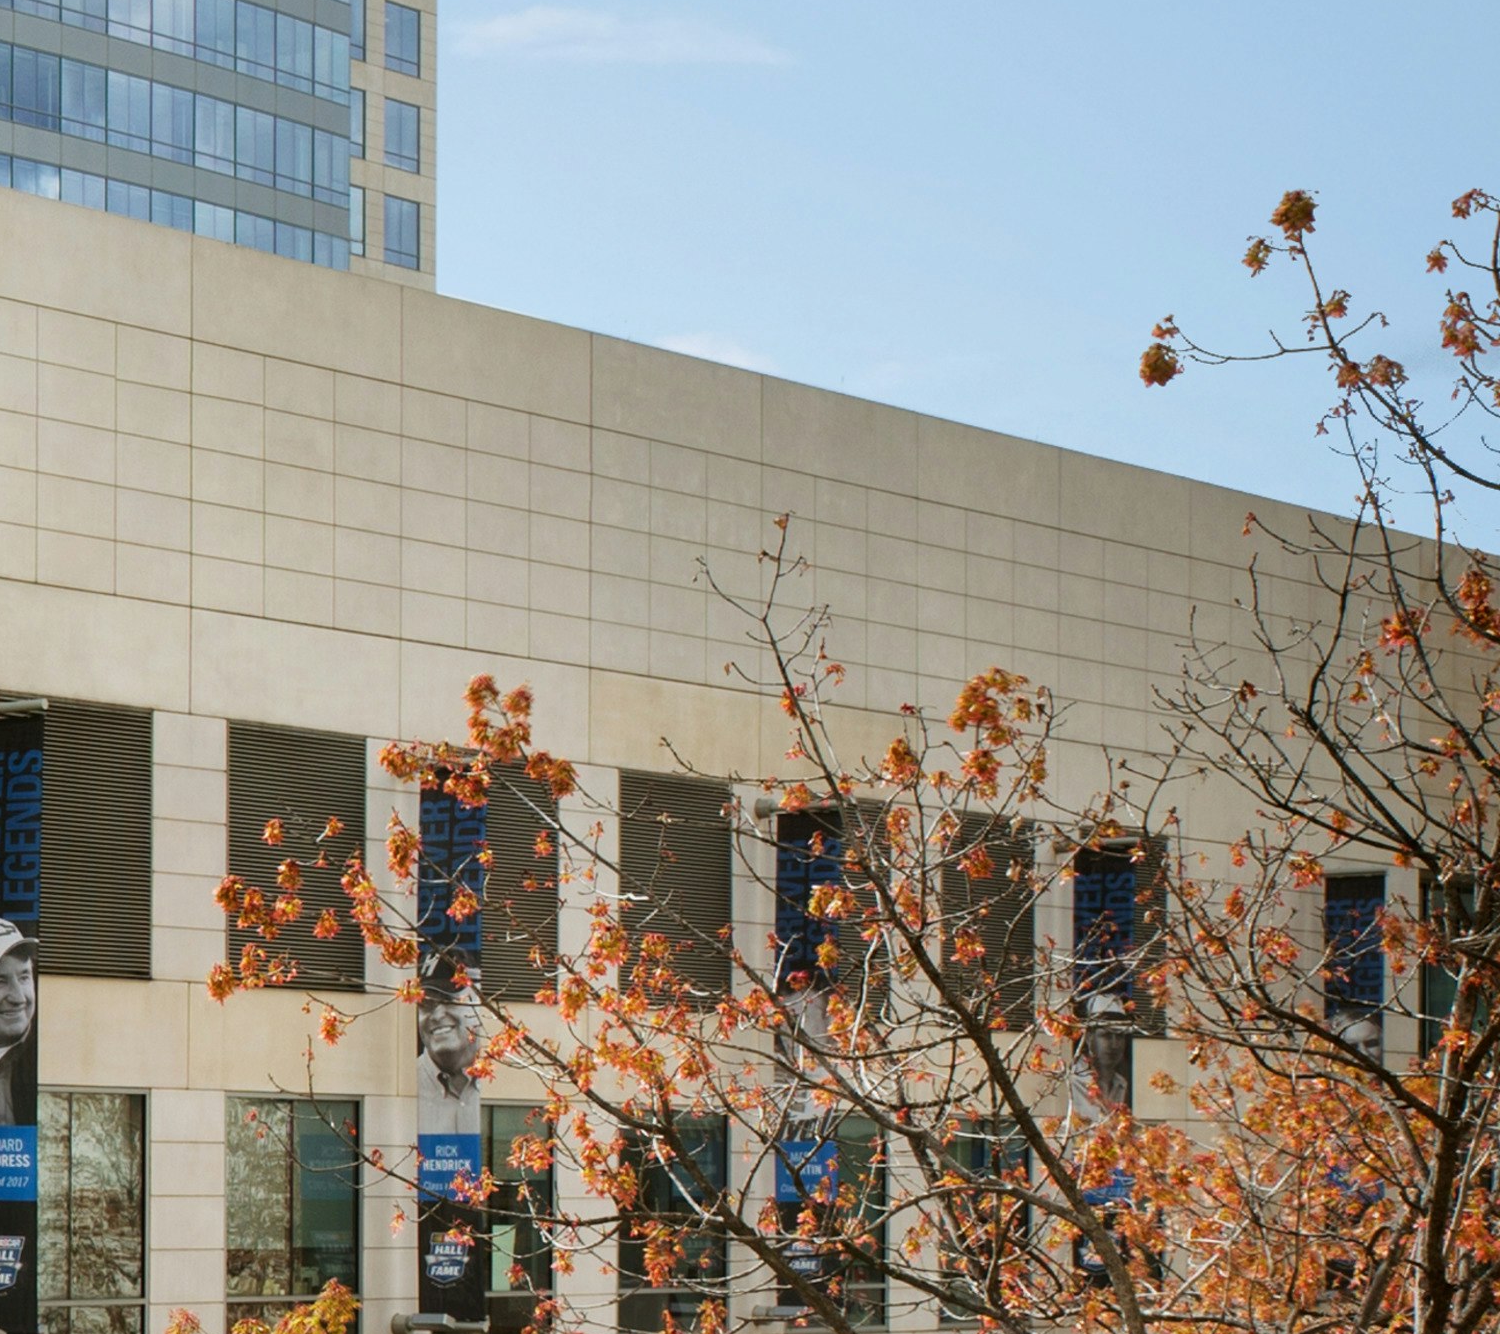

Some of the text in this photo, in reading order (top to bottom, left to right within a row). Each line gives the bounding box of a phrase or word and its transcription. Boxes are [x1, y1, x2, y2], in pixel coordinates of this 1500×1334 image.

[2, 748, 43, 922] LEGENDS
[435, 1144, 458, 1157] RICK
[423, 1159, 472, 1171] HENDRICK
[6, 1175, 29, 1188] 2017
[434, 1245, 464, 1256] HALL
[430, 1266, 461, 1277] FAME
